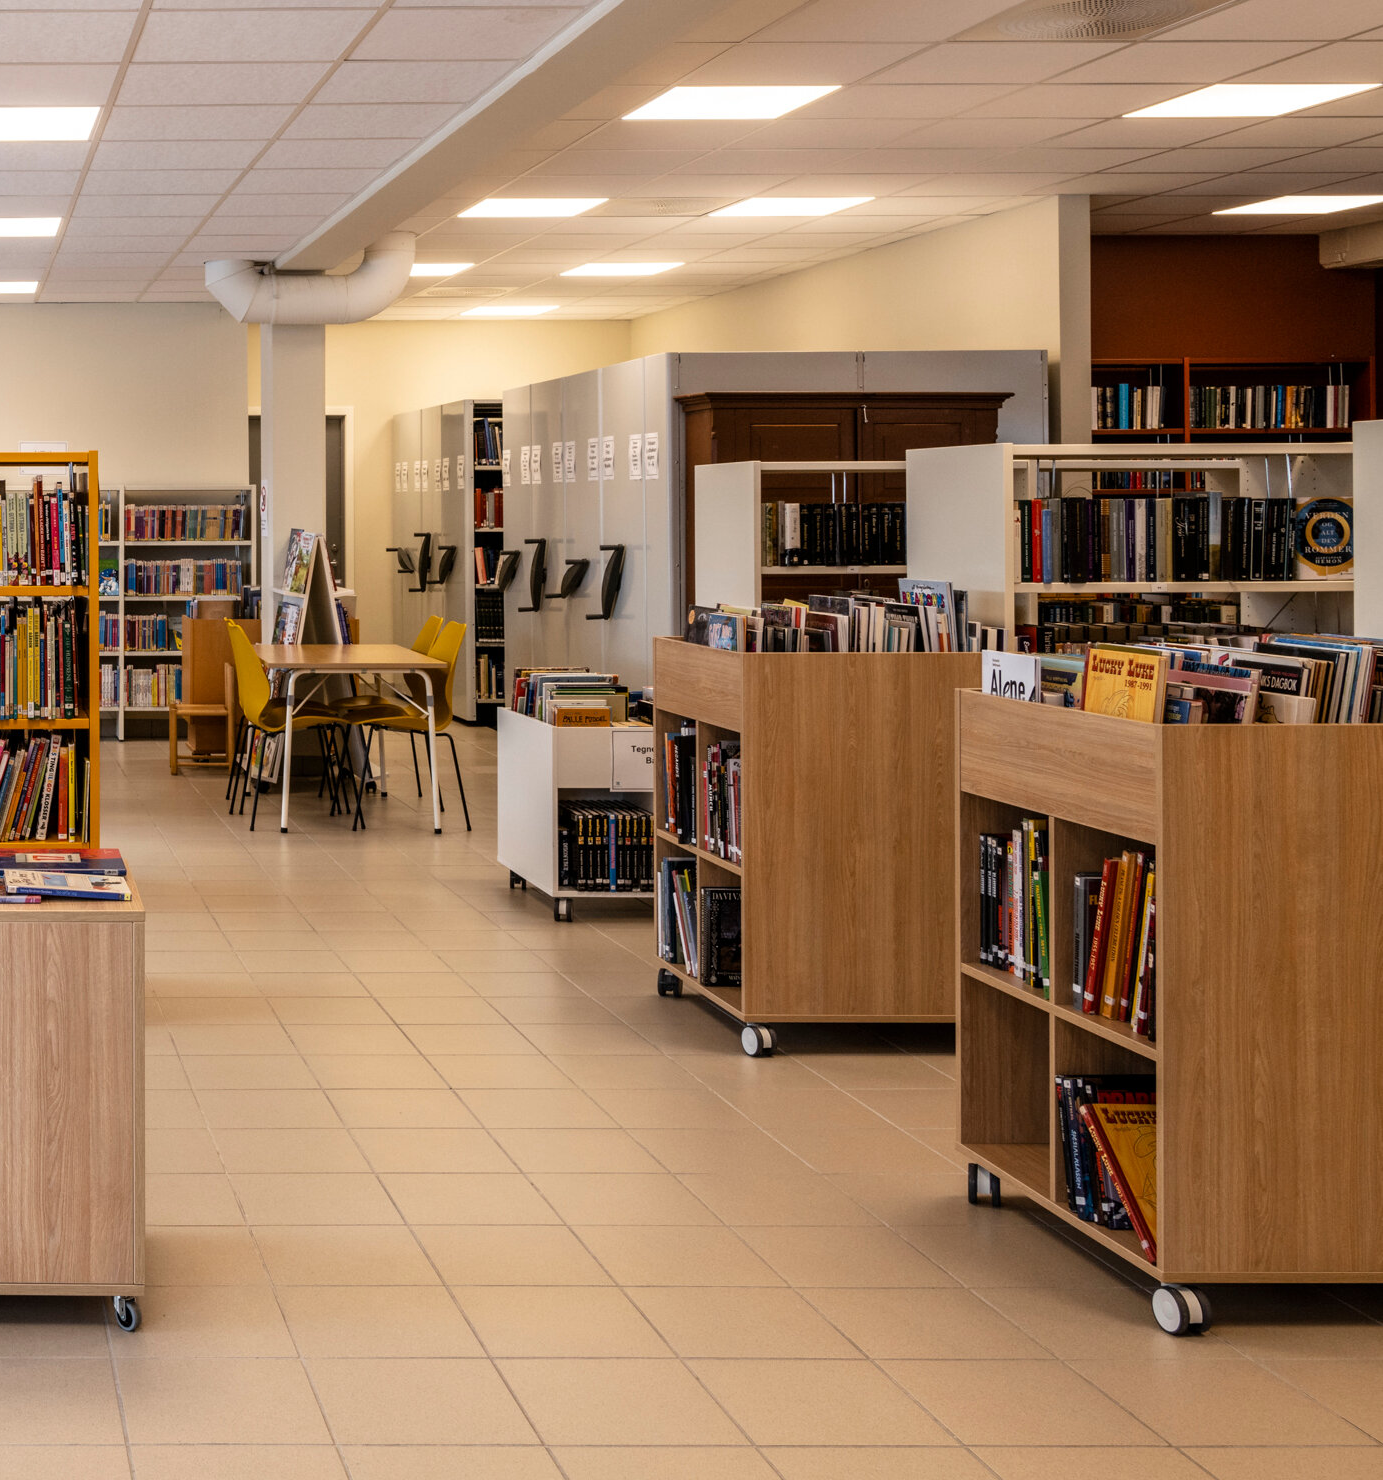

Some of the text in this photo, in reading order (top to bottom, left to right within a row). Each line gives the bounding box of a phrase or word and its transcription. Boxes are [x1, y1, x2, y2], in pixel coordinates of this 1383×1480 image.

[1304, 545, 1352, 553] ROMMER
[1091, 653, 1155, 681] LUCKY LUKE
[1124, 679, 1152, 691] 1987-1991
[1270, 676, 1298, 692] DAGBOK
[46, 756, 57, 773] TING
[41, 793, 50, 821] KLOSSER
[1088, 1125, 1114, 1177] LUCKY LUKE
